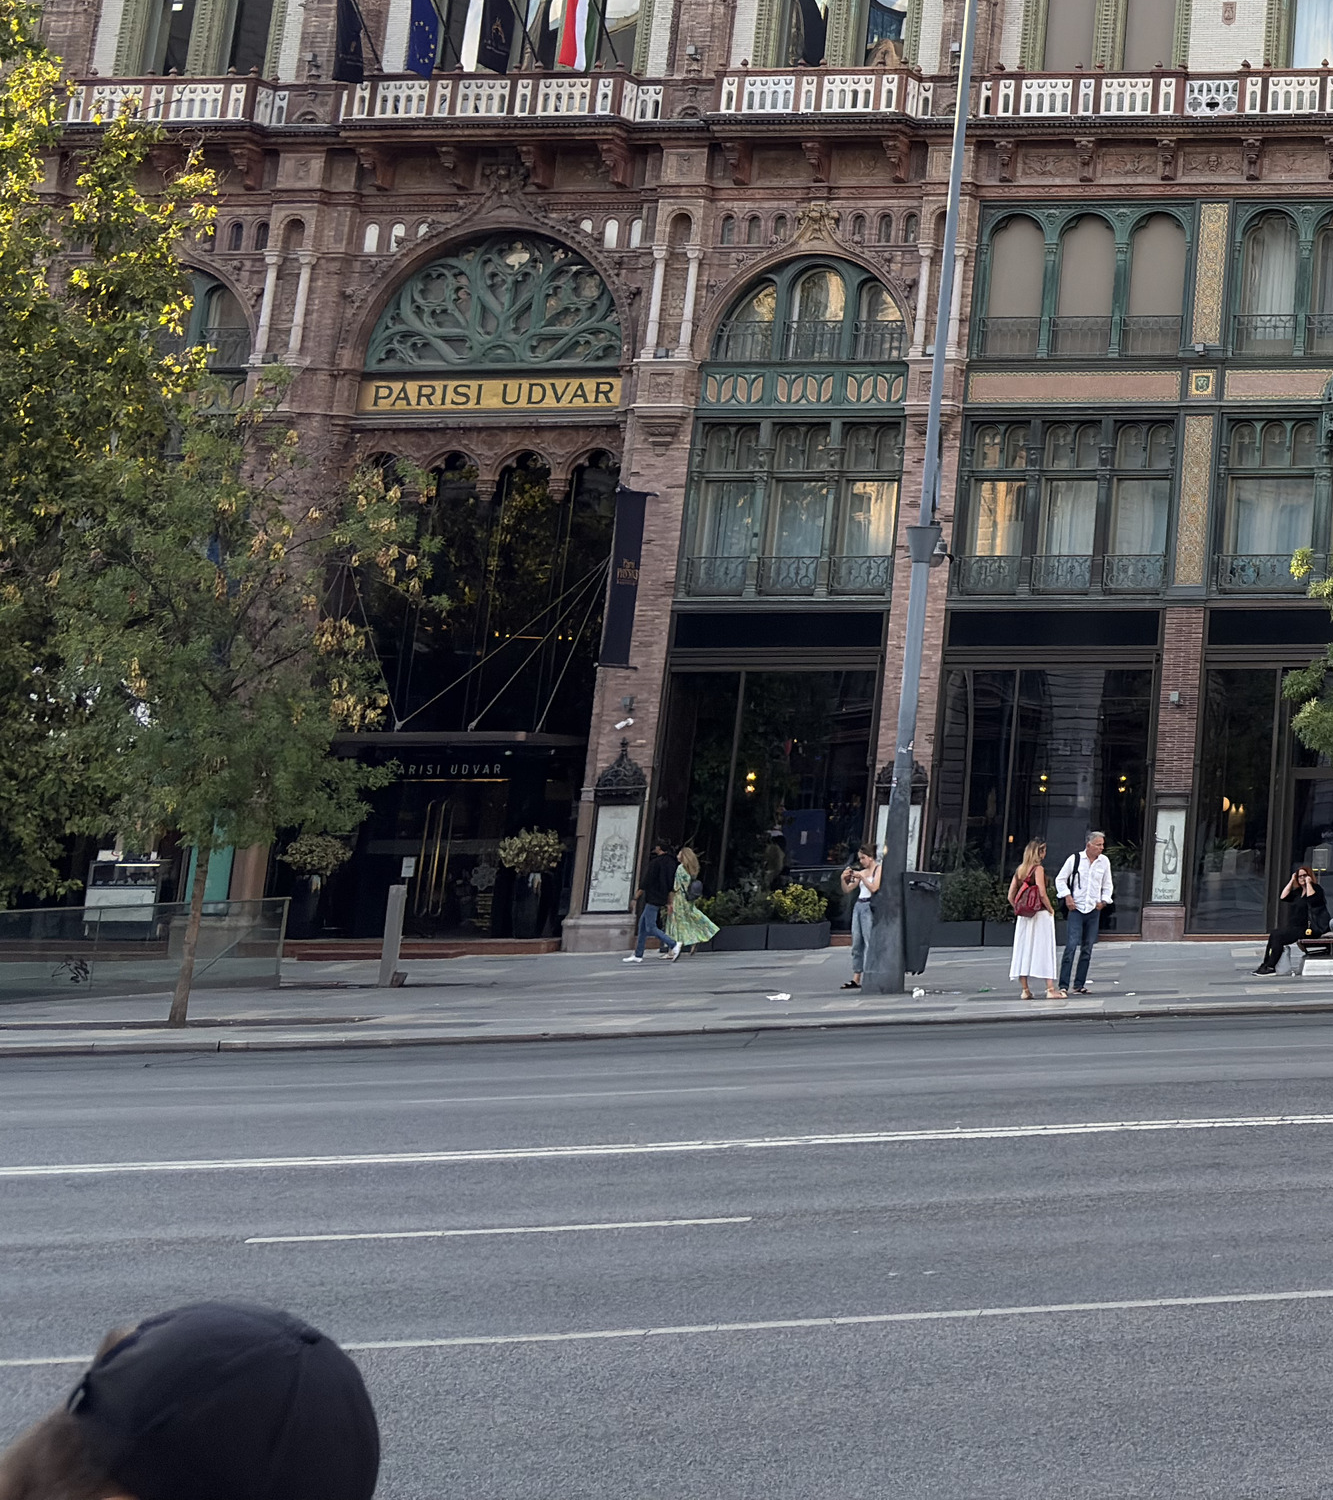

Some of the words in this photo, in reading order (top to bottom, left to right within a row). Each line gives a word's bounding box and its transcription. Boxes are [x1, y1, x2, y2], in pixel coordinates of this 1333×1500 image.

[501, 381, 615, 405] UDVAR
[397, 764, 441, 775] ARISI
[450, 764, 501, 775] UDVAR
